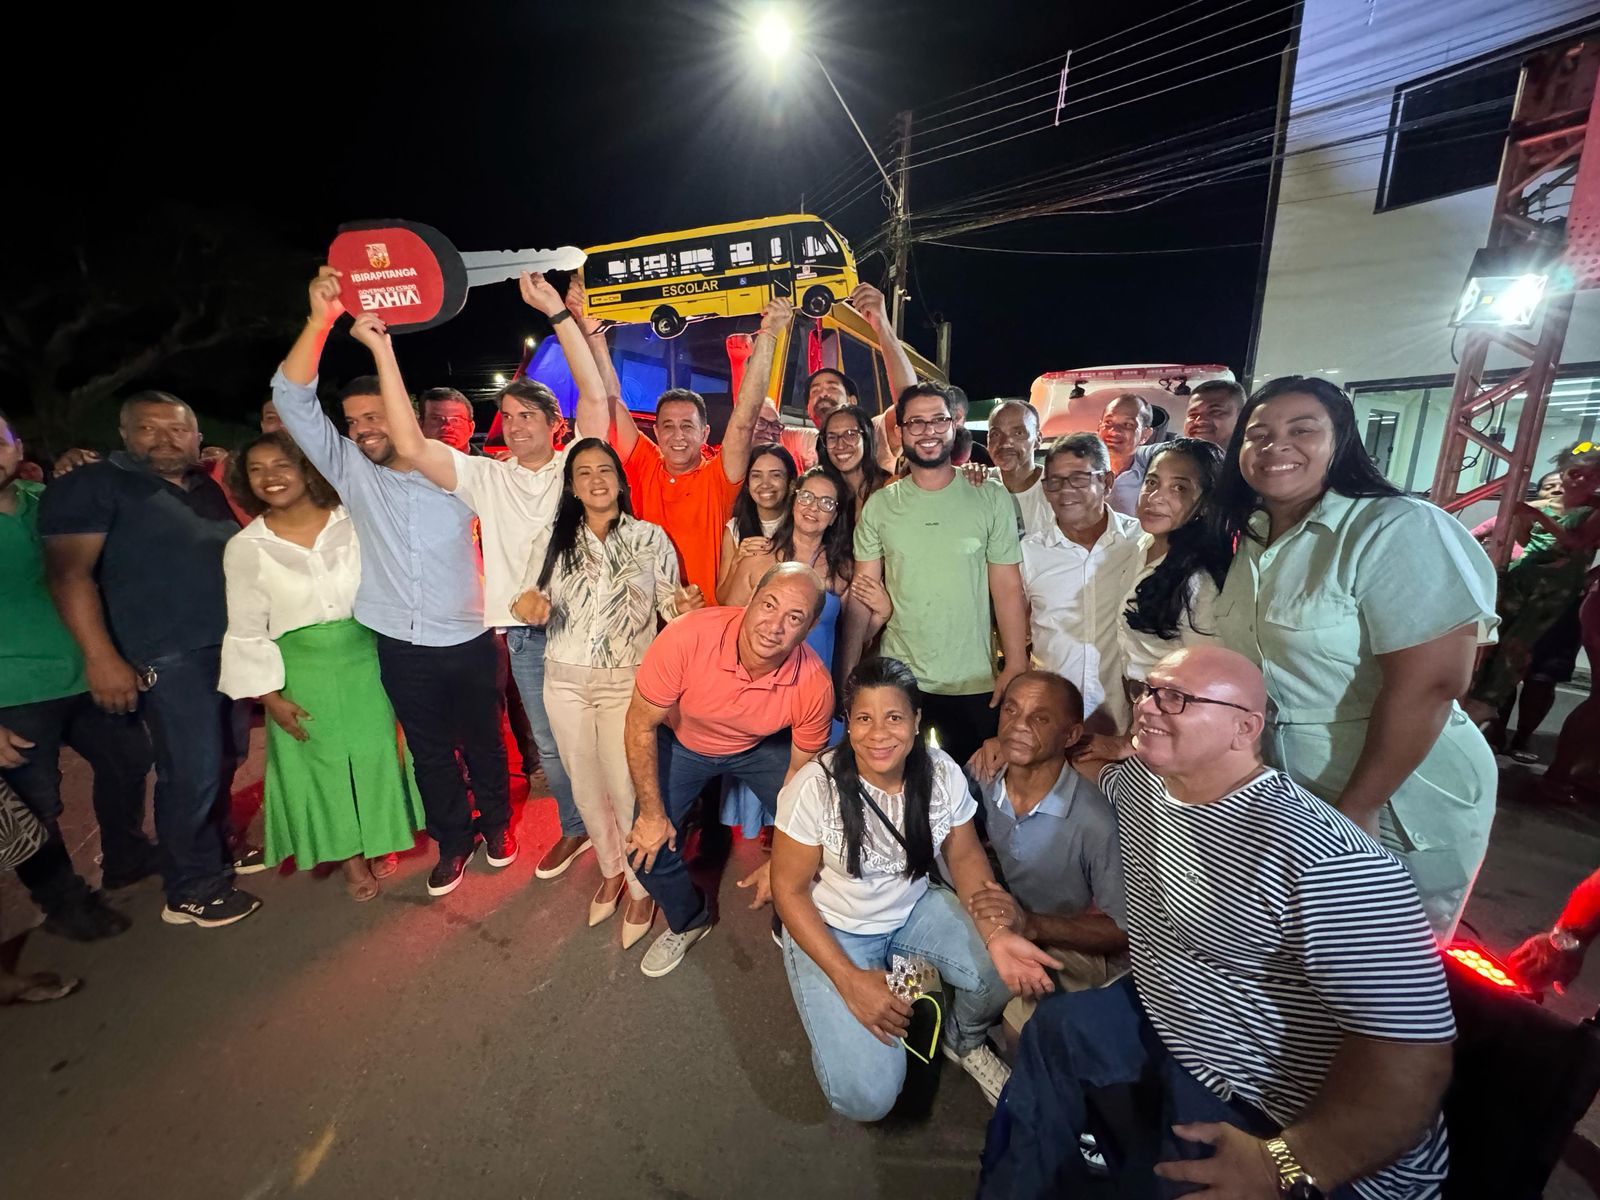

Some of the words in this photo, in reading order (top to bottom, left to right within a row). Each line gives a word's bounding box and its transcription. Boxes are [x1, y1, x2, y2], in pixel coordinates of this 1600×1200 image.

[351, 267, 417, 282] IBIRAPITANGA
[358, 287, 386, 295] GOVERNO
[662, 280, 719, 297] ESCOLAR
[360, 289, 421, 310] BAHIA
[180, 903, 205, 915] FILA
